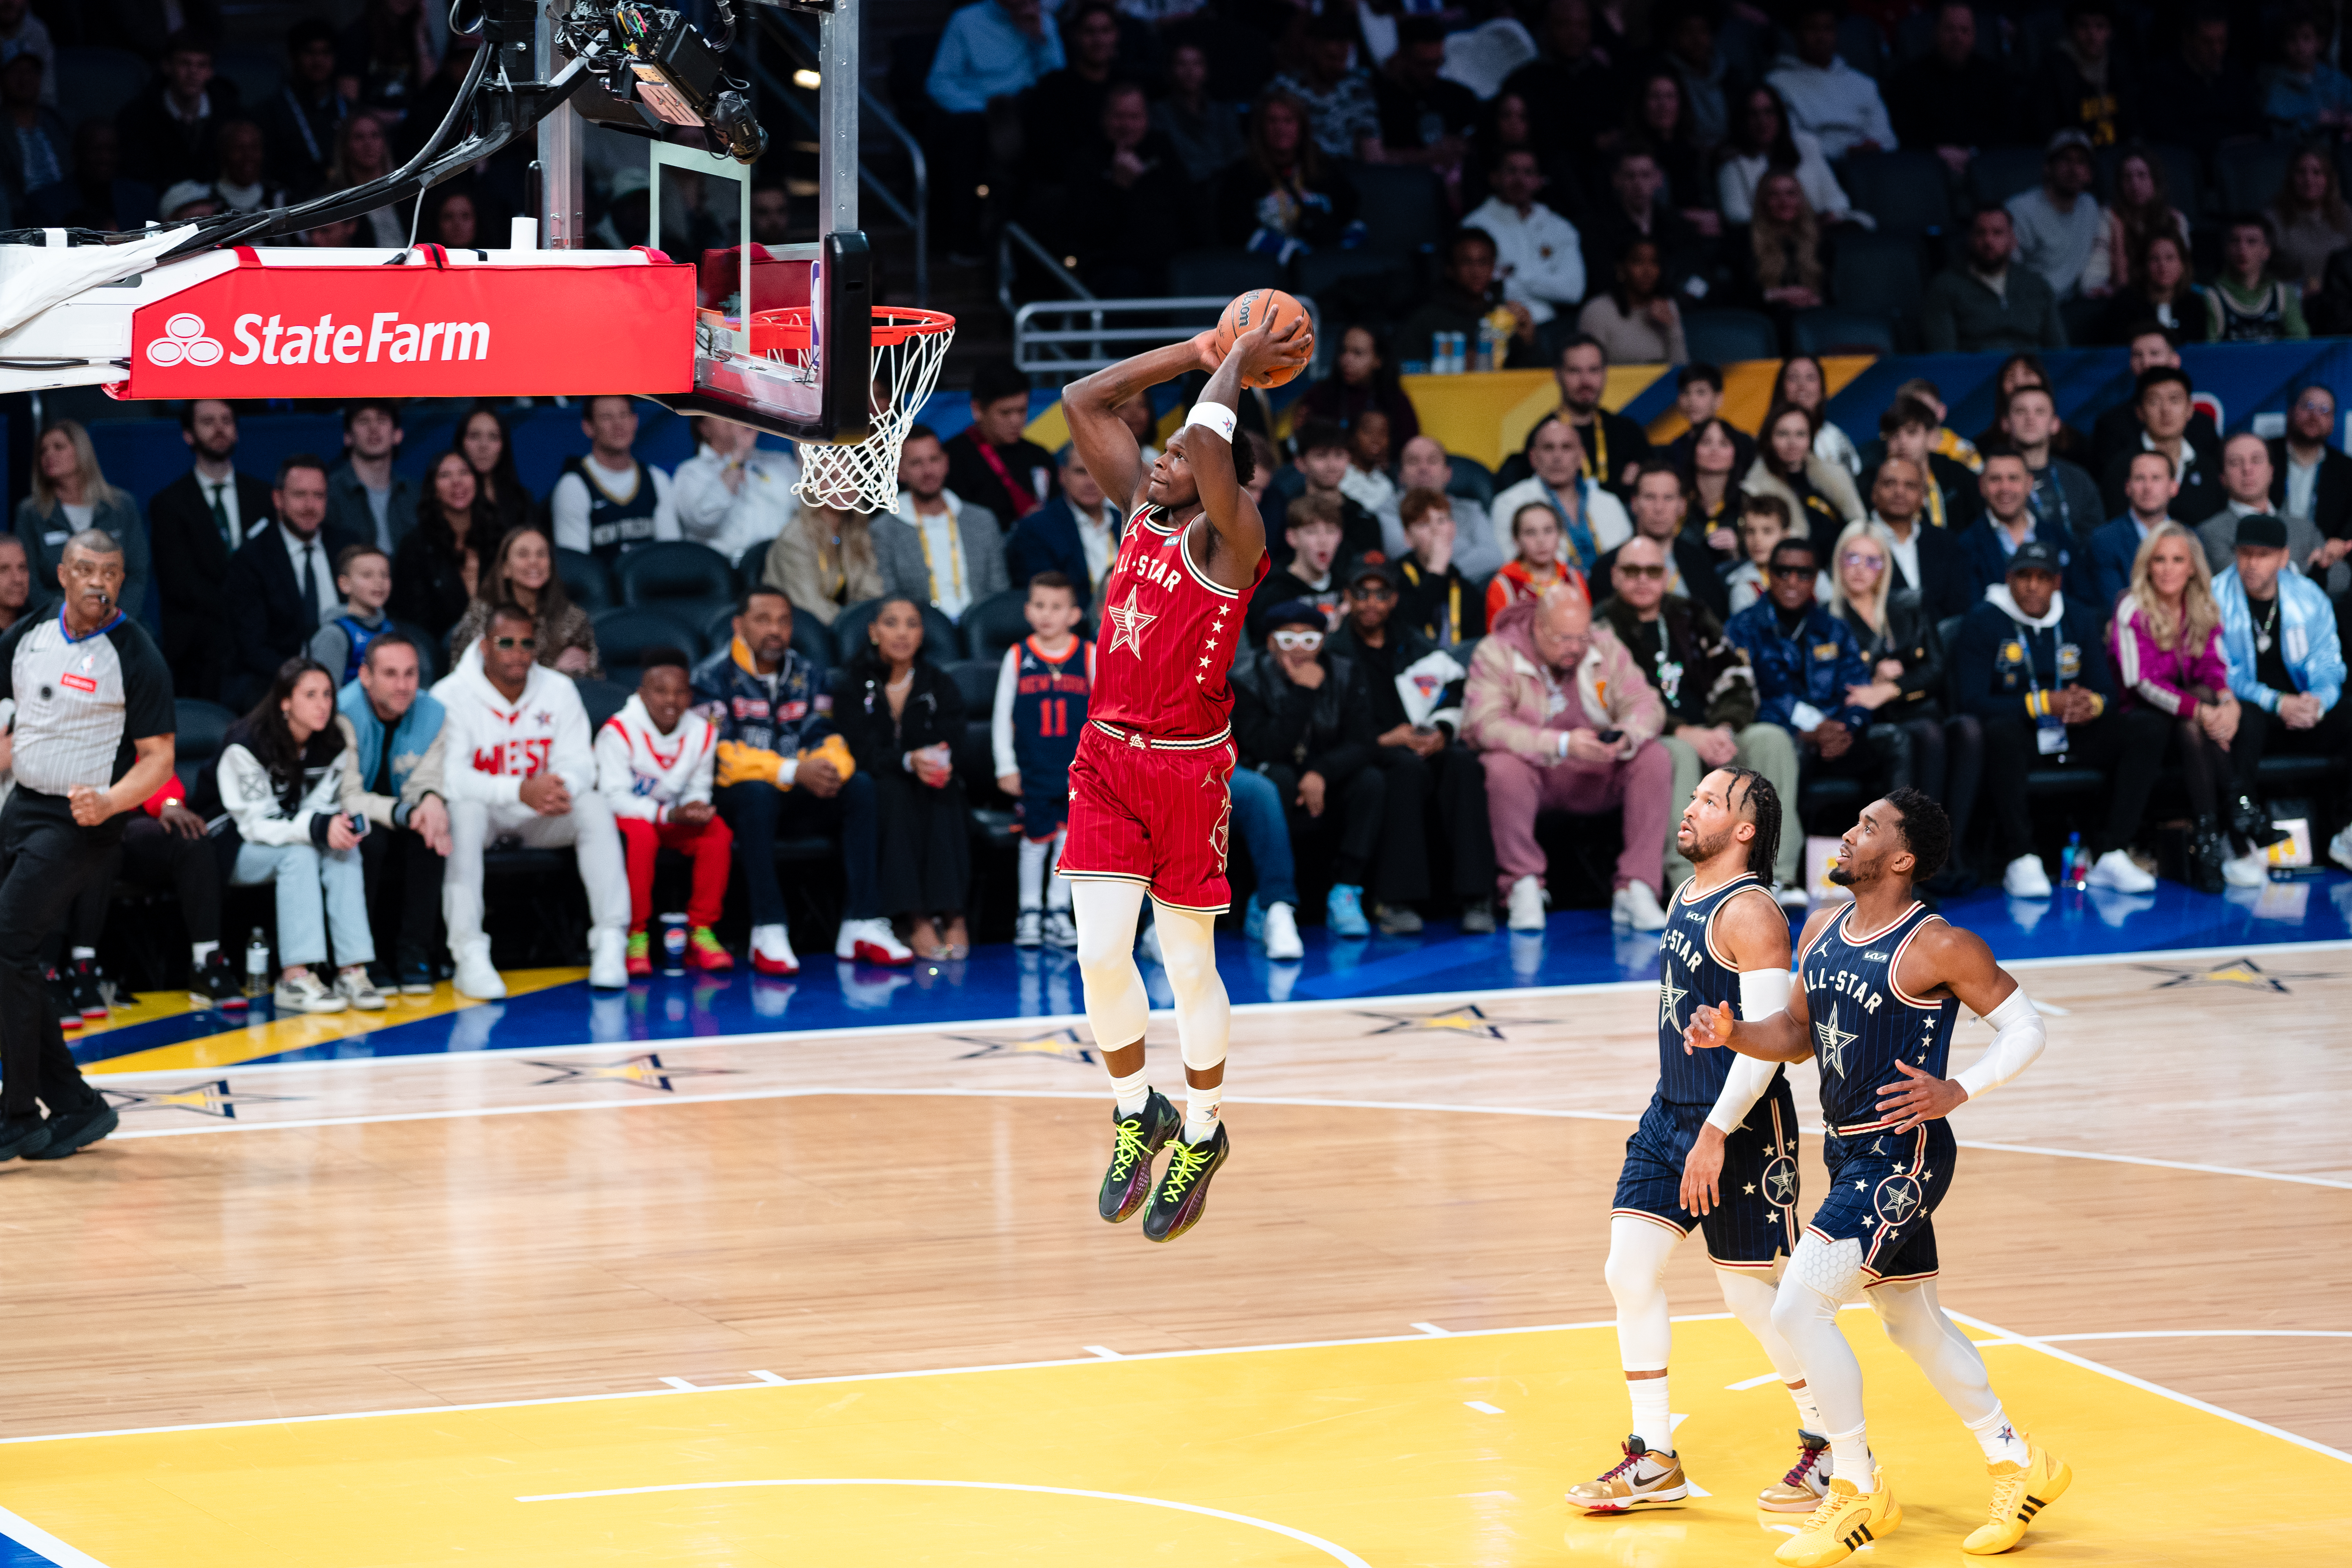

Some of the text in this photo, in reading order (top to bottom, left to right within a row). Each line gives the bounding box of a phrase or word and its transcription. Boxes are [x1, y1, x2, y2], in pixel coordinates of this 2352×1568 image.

[741, 124, 750, 136] Canon
[1039, 697, 1068, 737] 11
[473, 738, 553, 779] WEST
[1659, 929, 1703, 973] LL-STAR
[1803, 968, 1883, 1015] ALL-STAR
